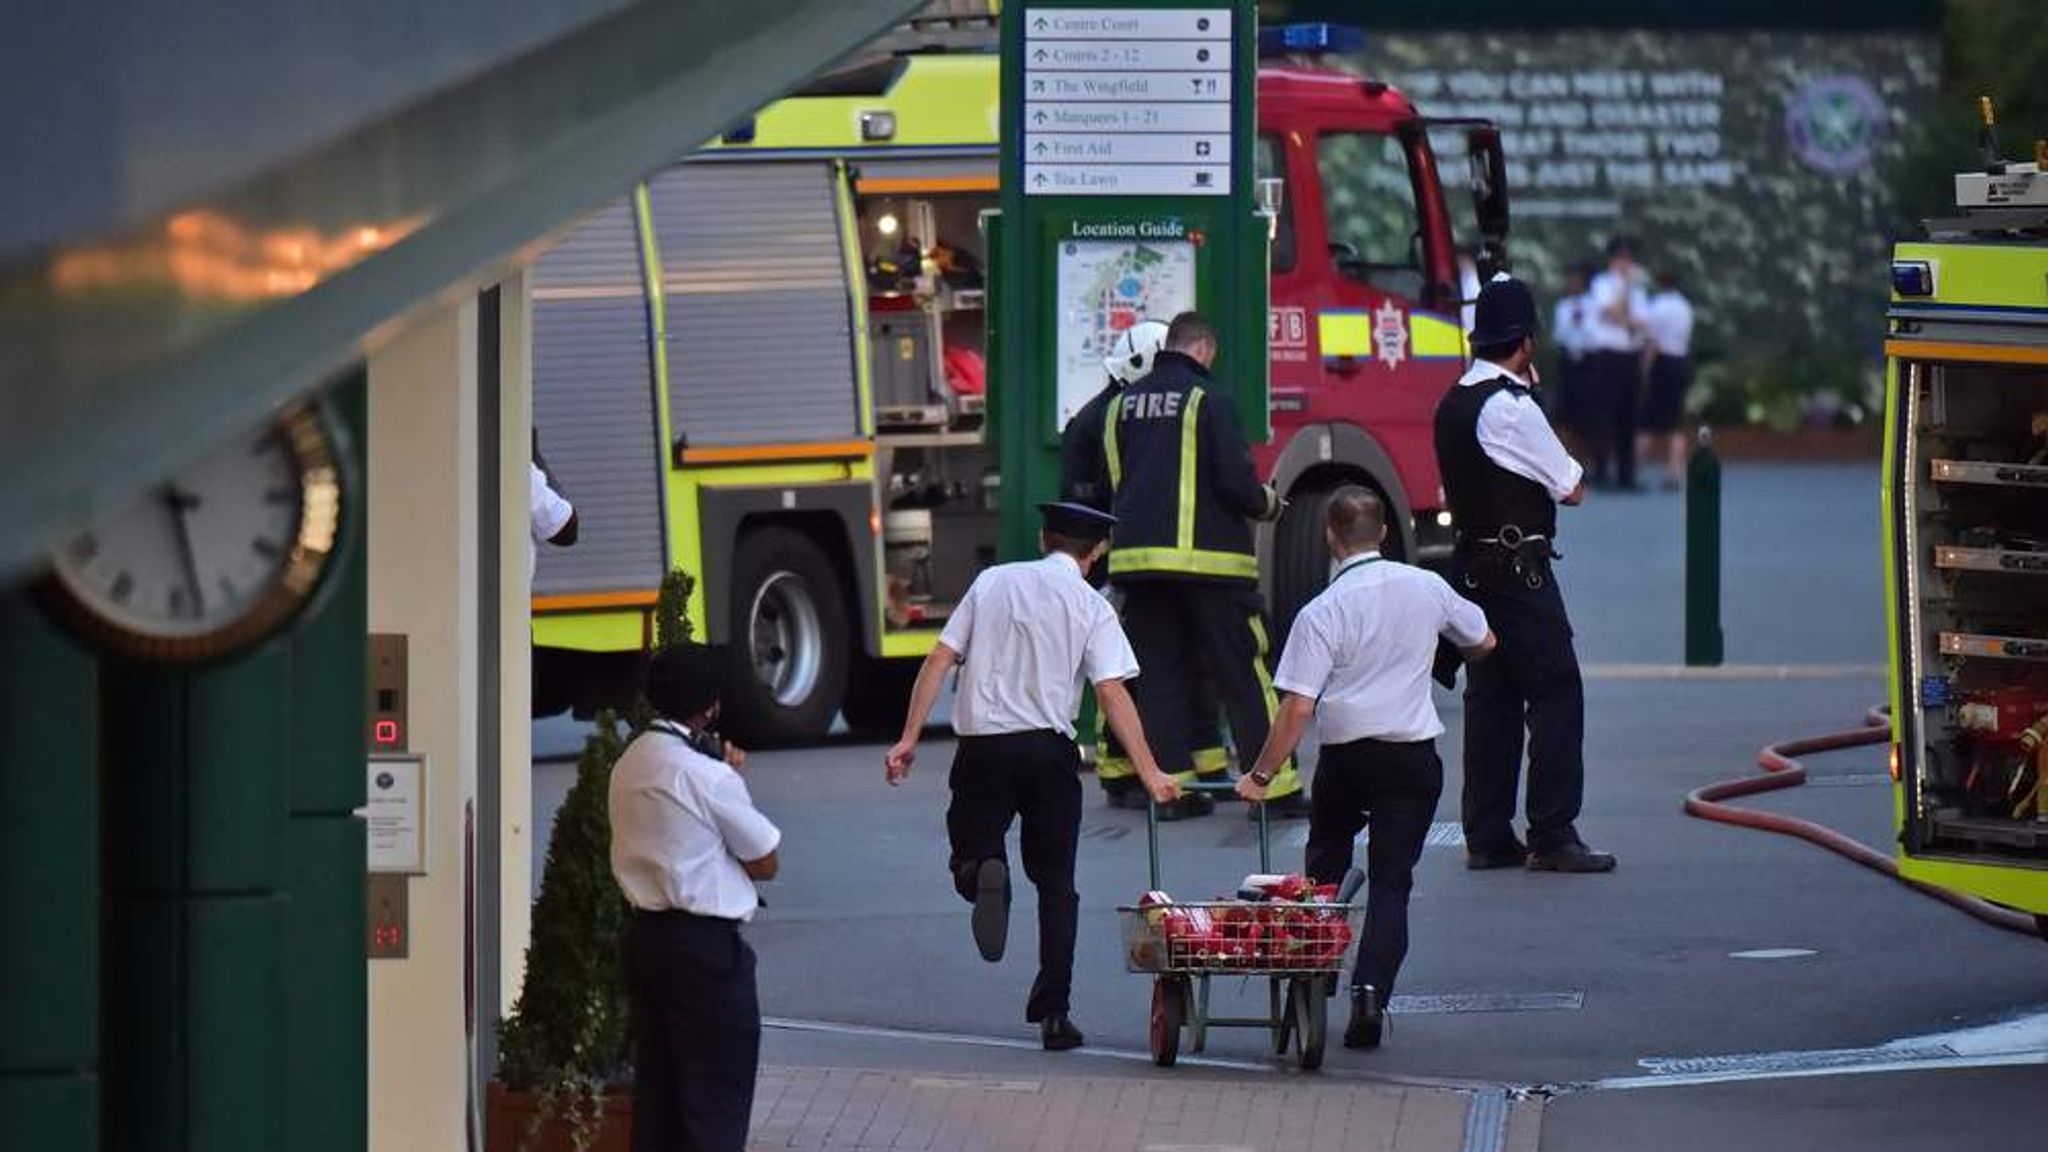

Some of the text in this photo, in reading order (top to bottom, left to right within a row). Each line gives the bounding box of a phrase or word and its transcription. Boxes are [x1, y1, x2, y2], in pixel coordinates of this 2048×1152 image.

[1053, 16, 1139, 29] Centre Court
[1053, 49, 1097, 62] Courts
[1101, 49, 1110, 62] 2
[1123, 49, 1140, 62] 12
[1055, 79, 1148, 95] The Wingfield
[1509, 71, 1568, 97] CAN
[1572, 71, 1644, 97] MEET
[1650, 71, 1722, 97] WITH
[1054, 111, 1118, 125] Marquees
[1527, 102, 1587, 127] AND
[1592, 102, 1721, 127] DISASTER
[1054, 141, 1112, 155] First Aid
[1561, 131, 1648, 156] THOSE
[1656, 131, 1720, 156] TWO
[1054, 174, 1117, 186] Tea Lawn
[1538, 161, 1597, 186] JUST
[1605, 161, 1655, 186] THE
[1073, 221, 1184, 236] Location Guide
[1122, 391, 1182, 421] FIRE
